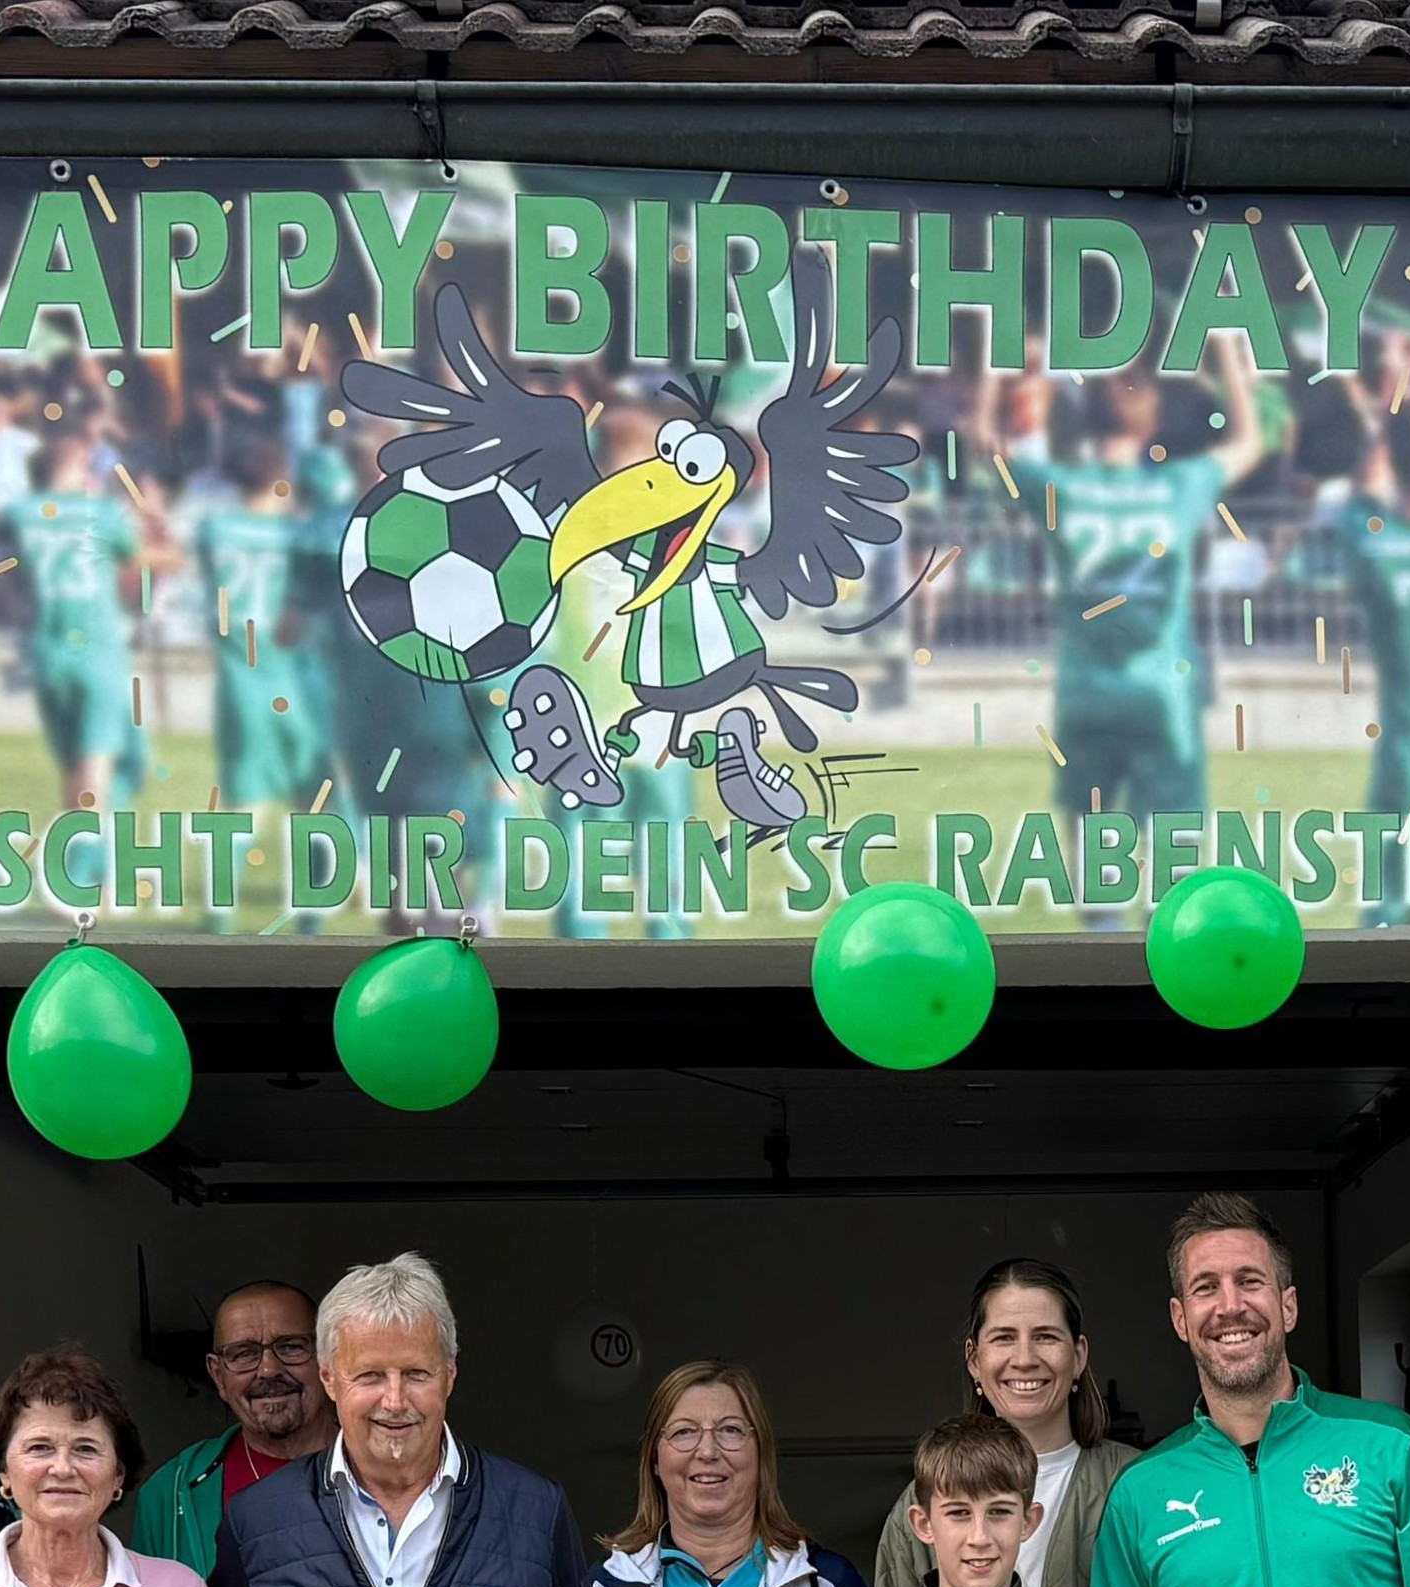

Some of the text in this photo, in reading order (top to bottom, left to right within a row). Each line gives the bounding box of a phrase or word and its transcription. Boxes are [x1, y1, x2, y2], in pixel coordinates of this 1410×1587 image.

[514, 192, 1396, 370] BIRTHDAY
[291, 811, 467, 912] DIR
[504, 815, 751, 914] DEIN
[786, 813, 896, 912] SC
[599, 1333, 628, 1358] 70
